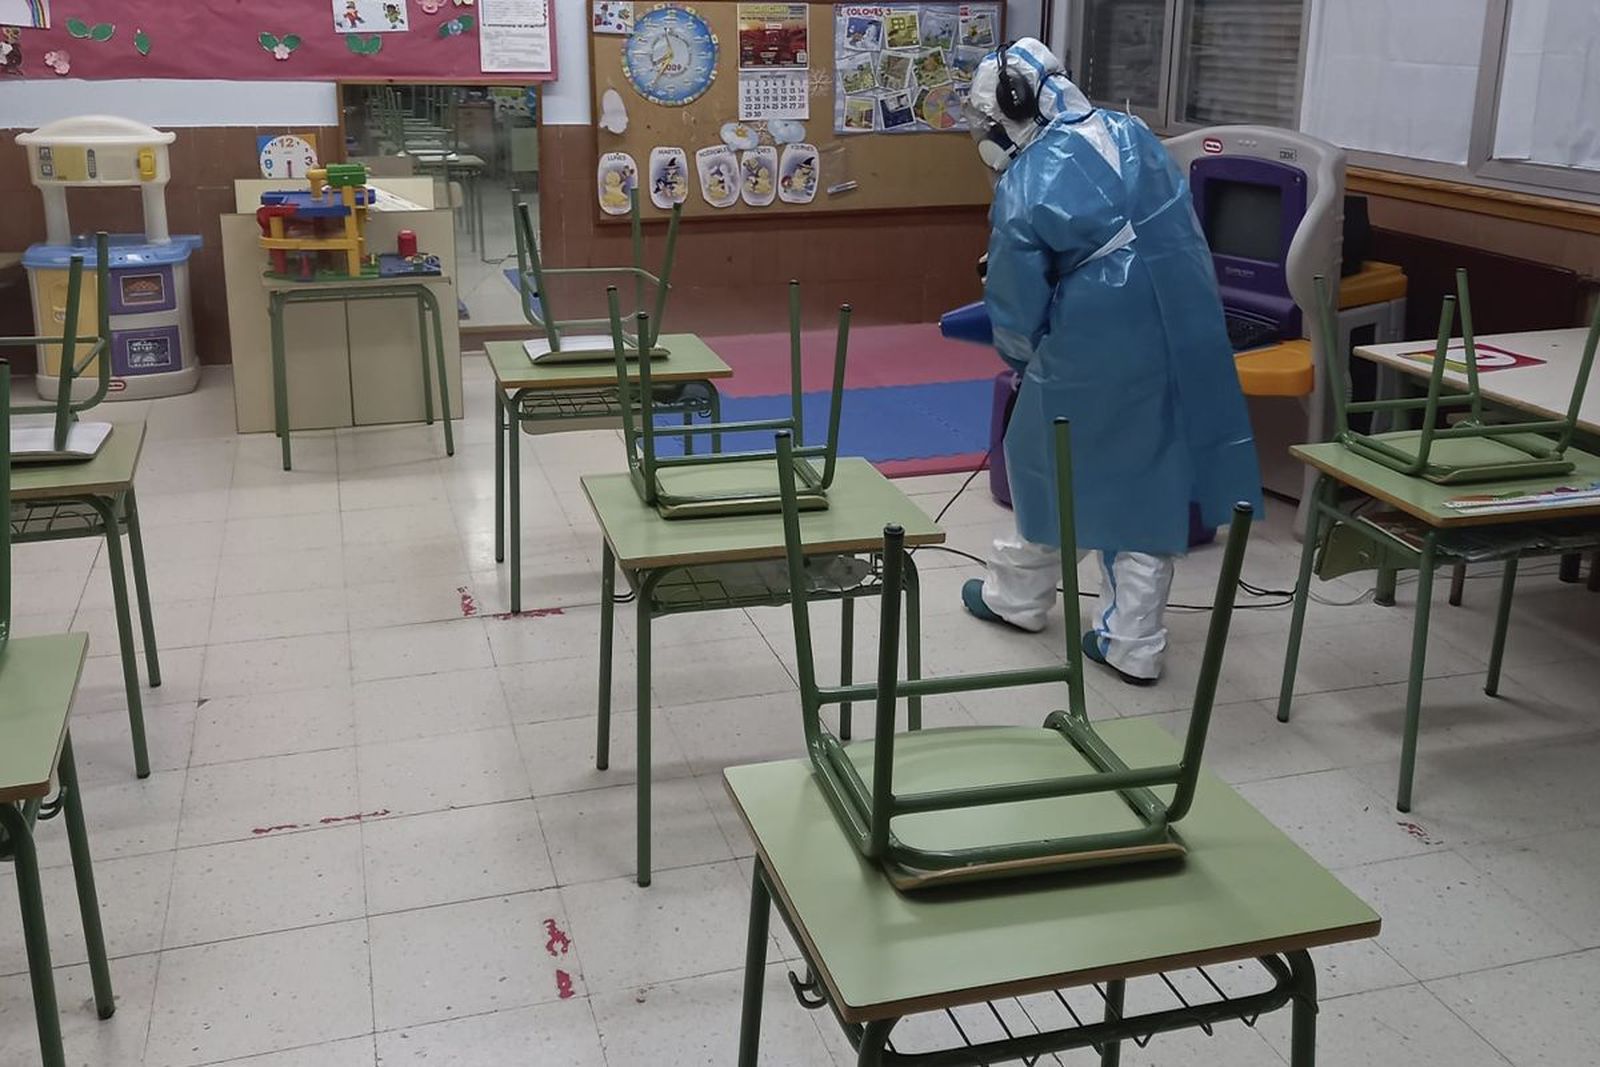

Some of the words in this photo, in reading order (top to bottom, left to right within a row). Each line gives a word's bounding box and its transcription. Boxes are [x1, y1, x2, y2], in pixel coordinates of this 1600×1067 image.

[846, 8, 883, 16] COLOURS
[279, 138, 294, 147] 12
[305, 156, 313, 166] 3
